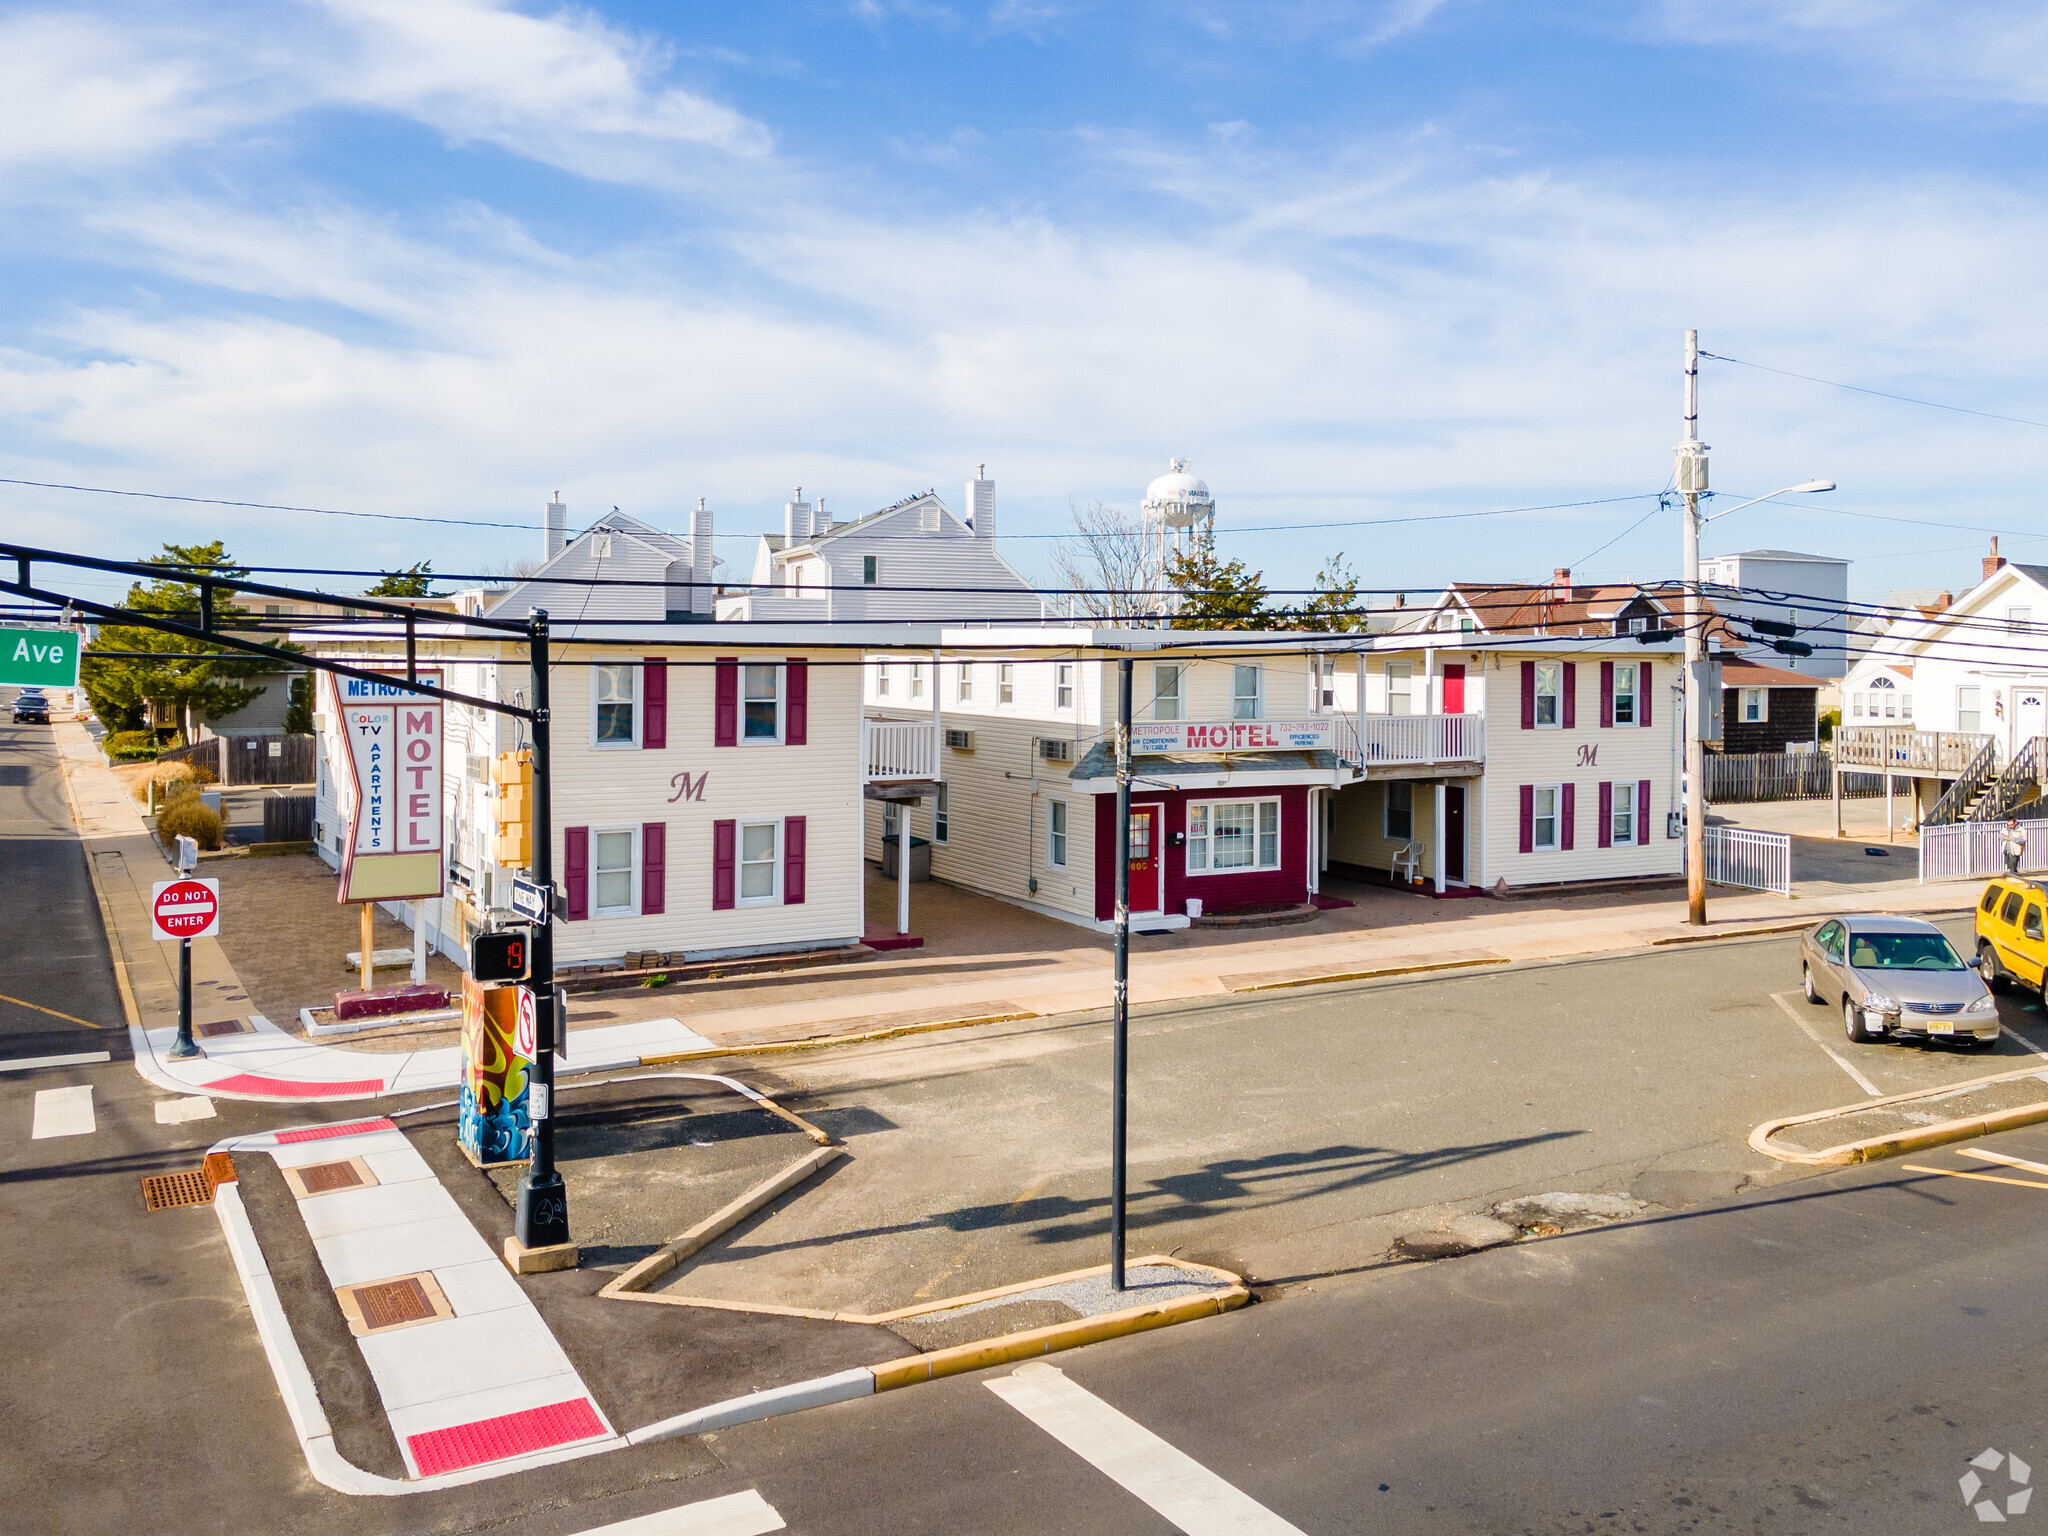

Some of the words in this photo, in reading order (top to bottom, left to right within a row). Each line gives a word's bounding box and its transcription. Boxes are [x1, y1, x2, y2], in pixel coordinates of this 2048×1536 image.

[12, 638, 64, 663] Ave
[359, 725, 382, 736] TV
[1131, 726, 1180, 736] METROPOLE
[1187, 725, 1279, 748] MOTEL
[1280, 722, 1329, 732] 732-793-1022
[1577, 743, 1599, 767] M
[406, 711, 433, 846] MOTEL
[667, 770, 709, 803] M
[370, 743, 382, 847] APARTMENTS
[163, 893, 179, 903] DO
[184, 890, 208, 901] NOT
[167, 916, 204, 928] ENTER
[508, 942, 522, 968] 19
